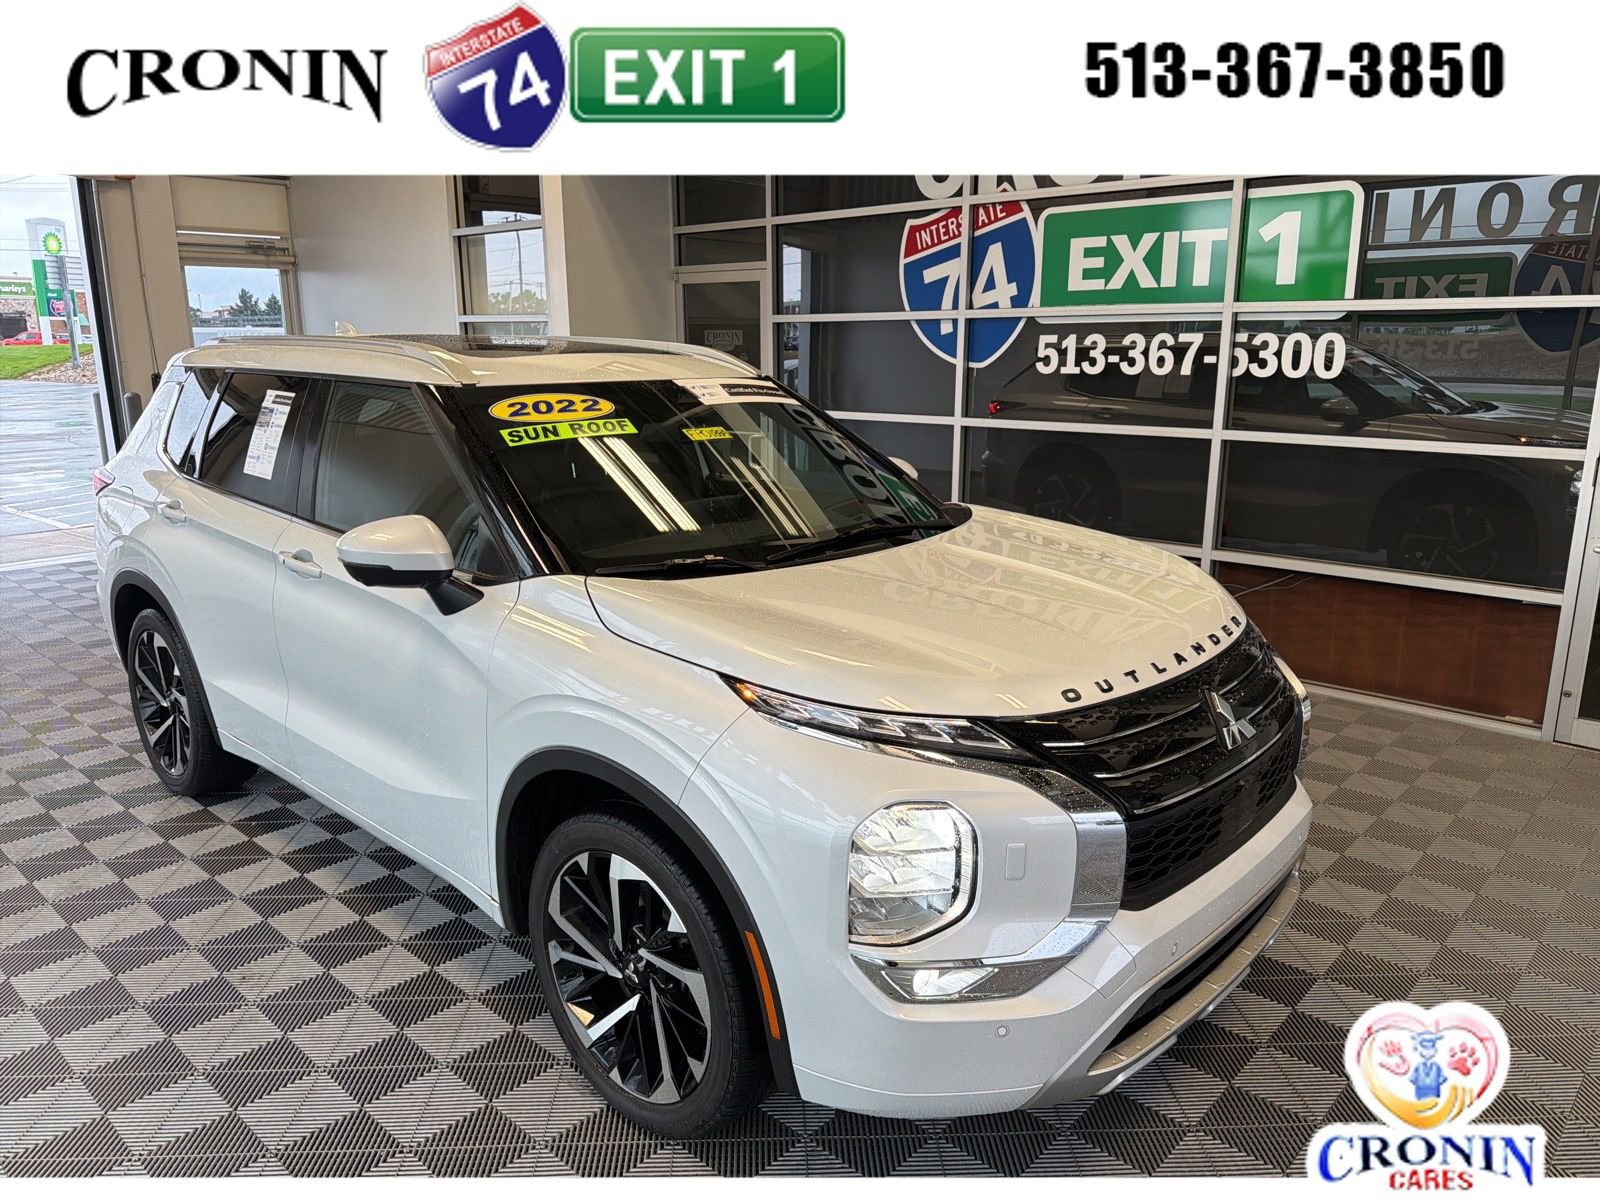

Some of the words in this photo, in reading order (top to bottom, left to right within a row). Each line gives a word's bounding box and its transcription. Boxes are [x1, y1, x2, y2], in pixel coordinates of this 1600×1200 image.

[1069, 228, 1228, 292] EXIT
[1259, 210, 1302, 286] 1
[922, 241, 1018, 336] 74
[1035, 332, 1346, 379] 513-367-5300
[507, 399, 602, 417] 2022
[507, 425, 560, 444] SUN
[568, 420, 629, 436] ROOF
[1060, 614, 1243, 704] OUTLANDER
